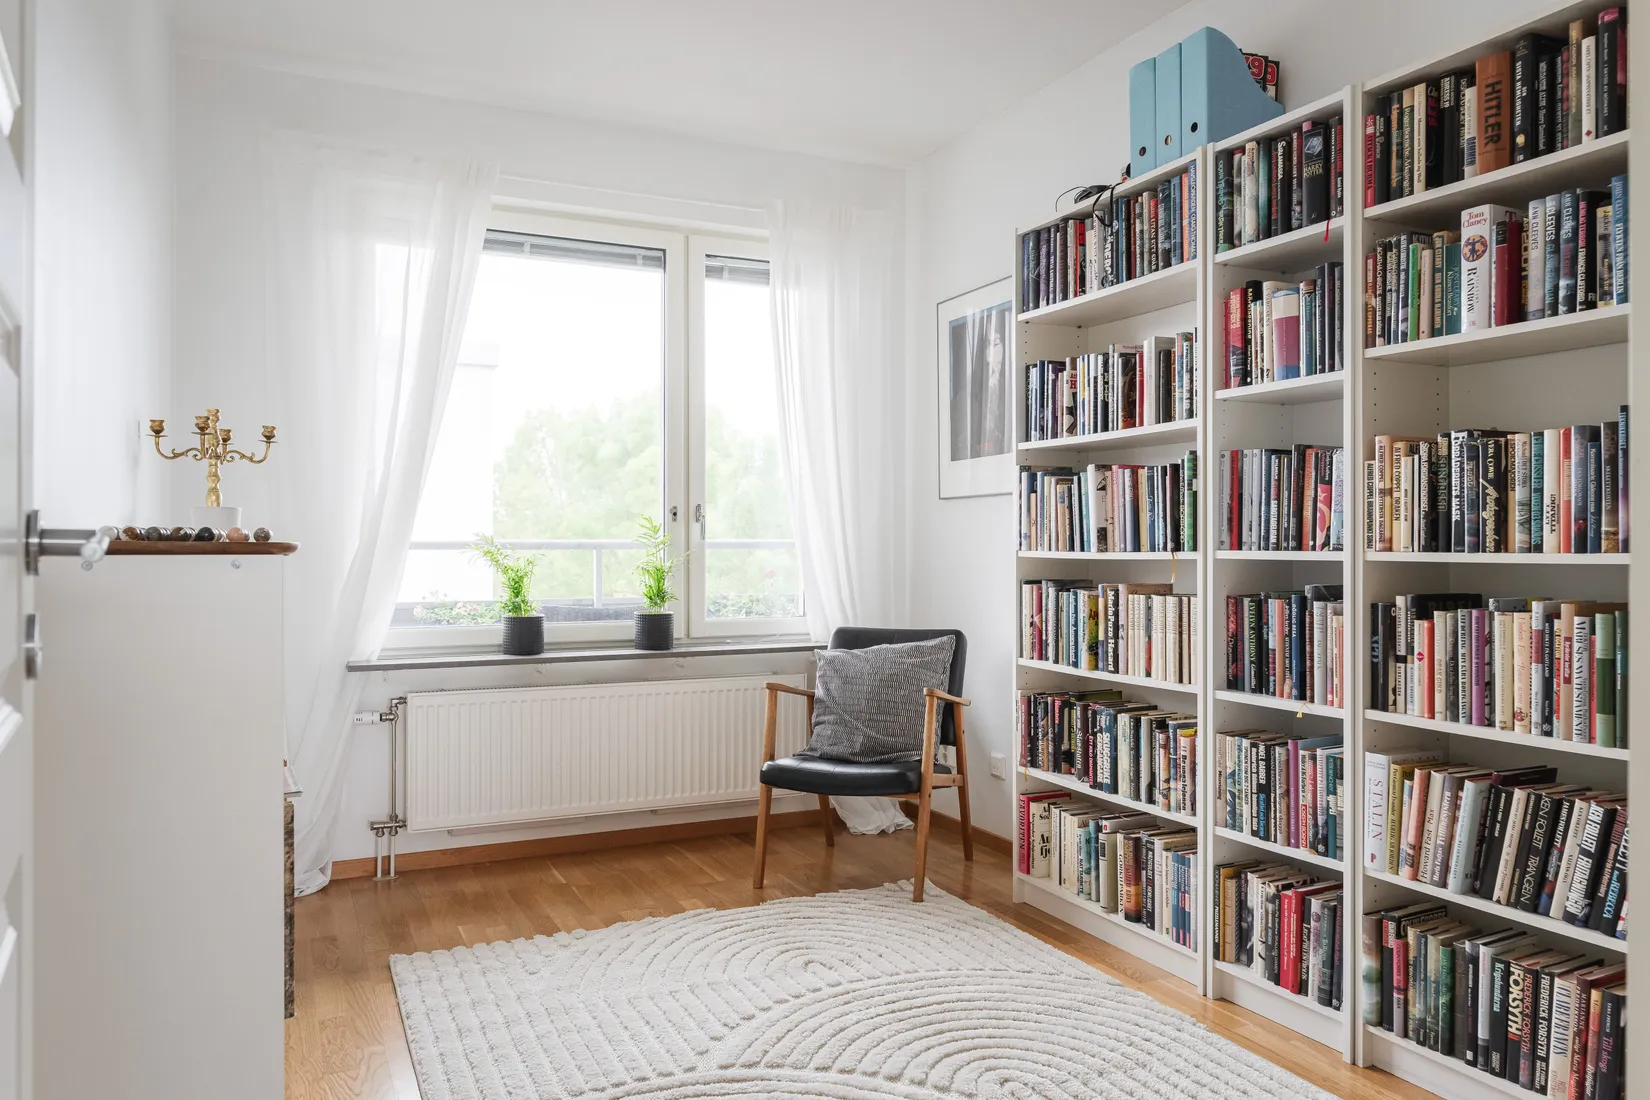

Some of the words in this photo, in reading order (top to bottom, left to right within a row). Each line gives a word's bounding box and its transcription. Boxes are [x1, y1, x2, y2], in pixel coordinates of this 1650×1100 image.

[1484, 80, 1502, 148] HITLER
[1304, 162, 1323, 174] HARRY
[1615, 182, 1623, 198] JOHN
[1462, 218, 1488, 228] Clancy
[1467, 212, 1484, 220] Tom
[1546, 207, 1555, 241] CLEEVES
[1563, 208, 1572, 238] CLEEVES
[1615, 200, 1623, 219] CLIVE
[1467, 268, 1478, 314] RAINBOW
[1532, 436, 1542, 456] CLIVE
[1533, 457, 1542, 488] CUSSLER
[1532, 493, 1541, 509] VIXEN
[1103, 732, 1111, 785] SKUGGRIKE
[1181, 754, 1187, 764] De
[1372, 779, 1383, 841] STALIN
[1437, 792, 1451, 845] Tvillingsystern
[1539, 796, 1552, 817] KEN
[1559, 801, 1570, 821] JAMES
[1590, 804, 1604, 820] KEN
[1424, 829, 1433, 846] Fast
[1532, 818, 1547, 849] FOLLETT
[1554, 822, 1566, 848] FOLLETT
[1581, 821, 1600, 853] FOLLETT
[1420, 847, 1431, 879] Howard
[1520, 855, 1540, 903] TRIANGELN
[1565, 855, 1592, 916] FRITAGNINGEN
[1603, 881, 1620, 919] REBECCA
[1493, 962, 1504, 1012] Krigshundarna
[1508, 967, 1523, 1034] FORSYTH
[1524, 973, 1532, 1015] FREDERICK
[1539, 975, 1550, 1018] FREDERICK
[1522, 1017, 1531, 1053] FORSYTH
[1537, 1019, 1548, 1057] FORSYTH
[1602, 1036, 1613, 1051] Till
[1599, 1051, 1611, 1073] skogs
